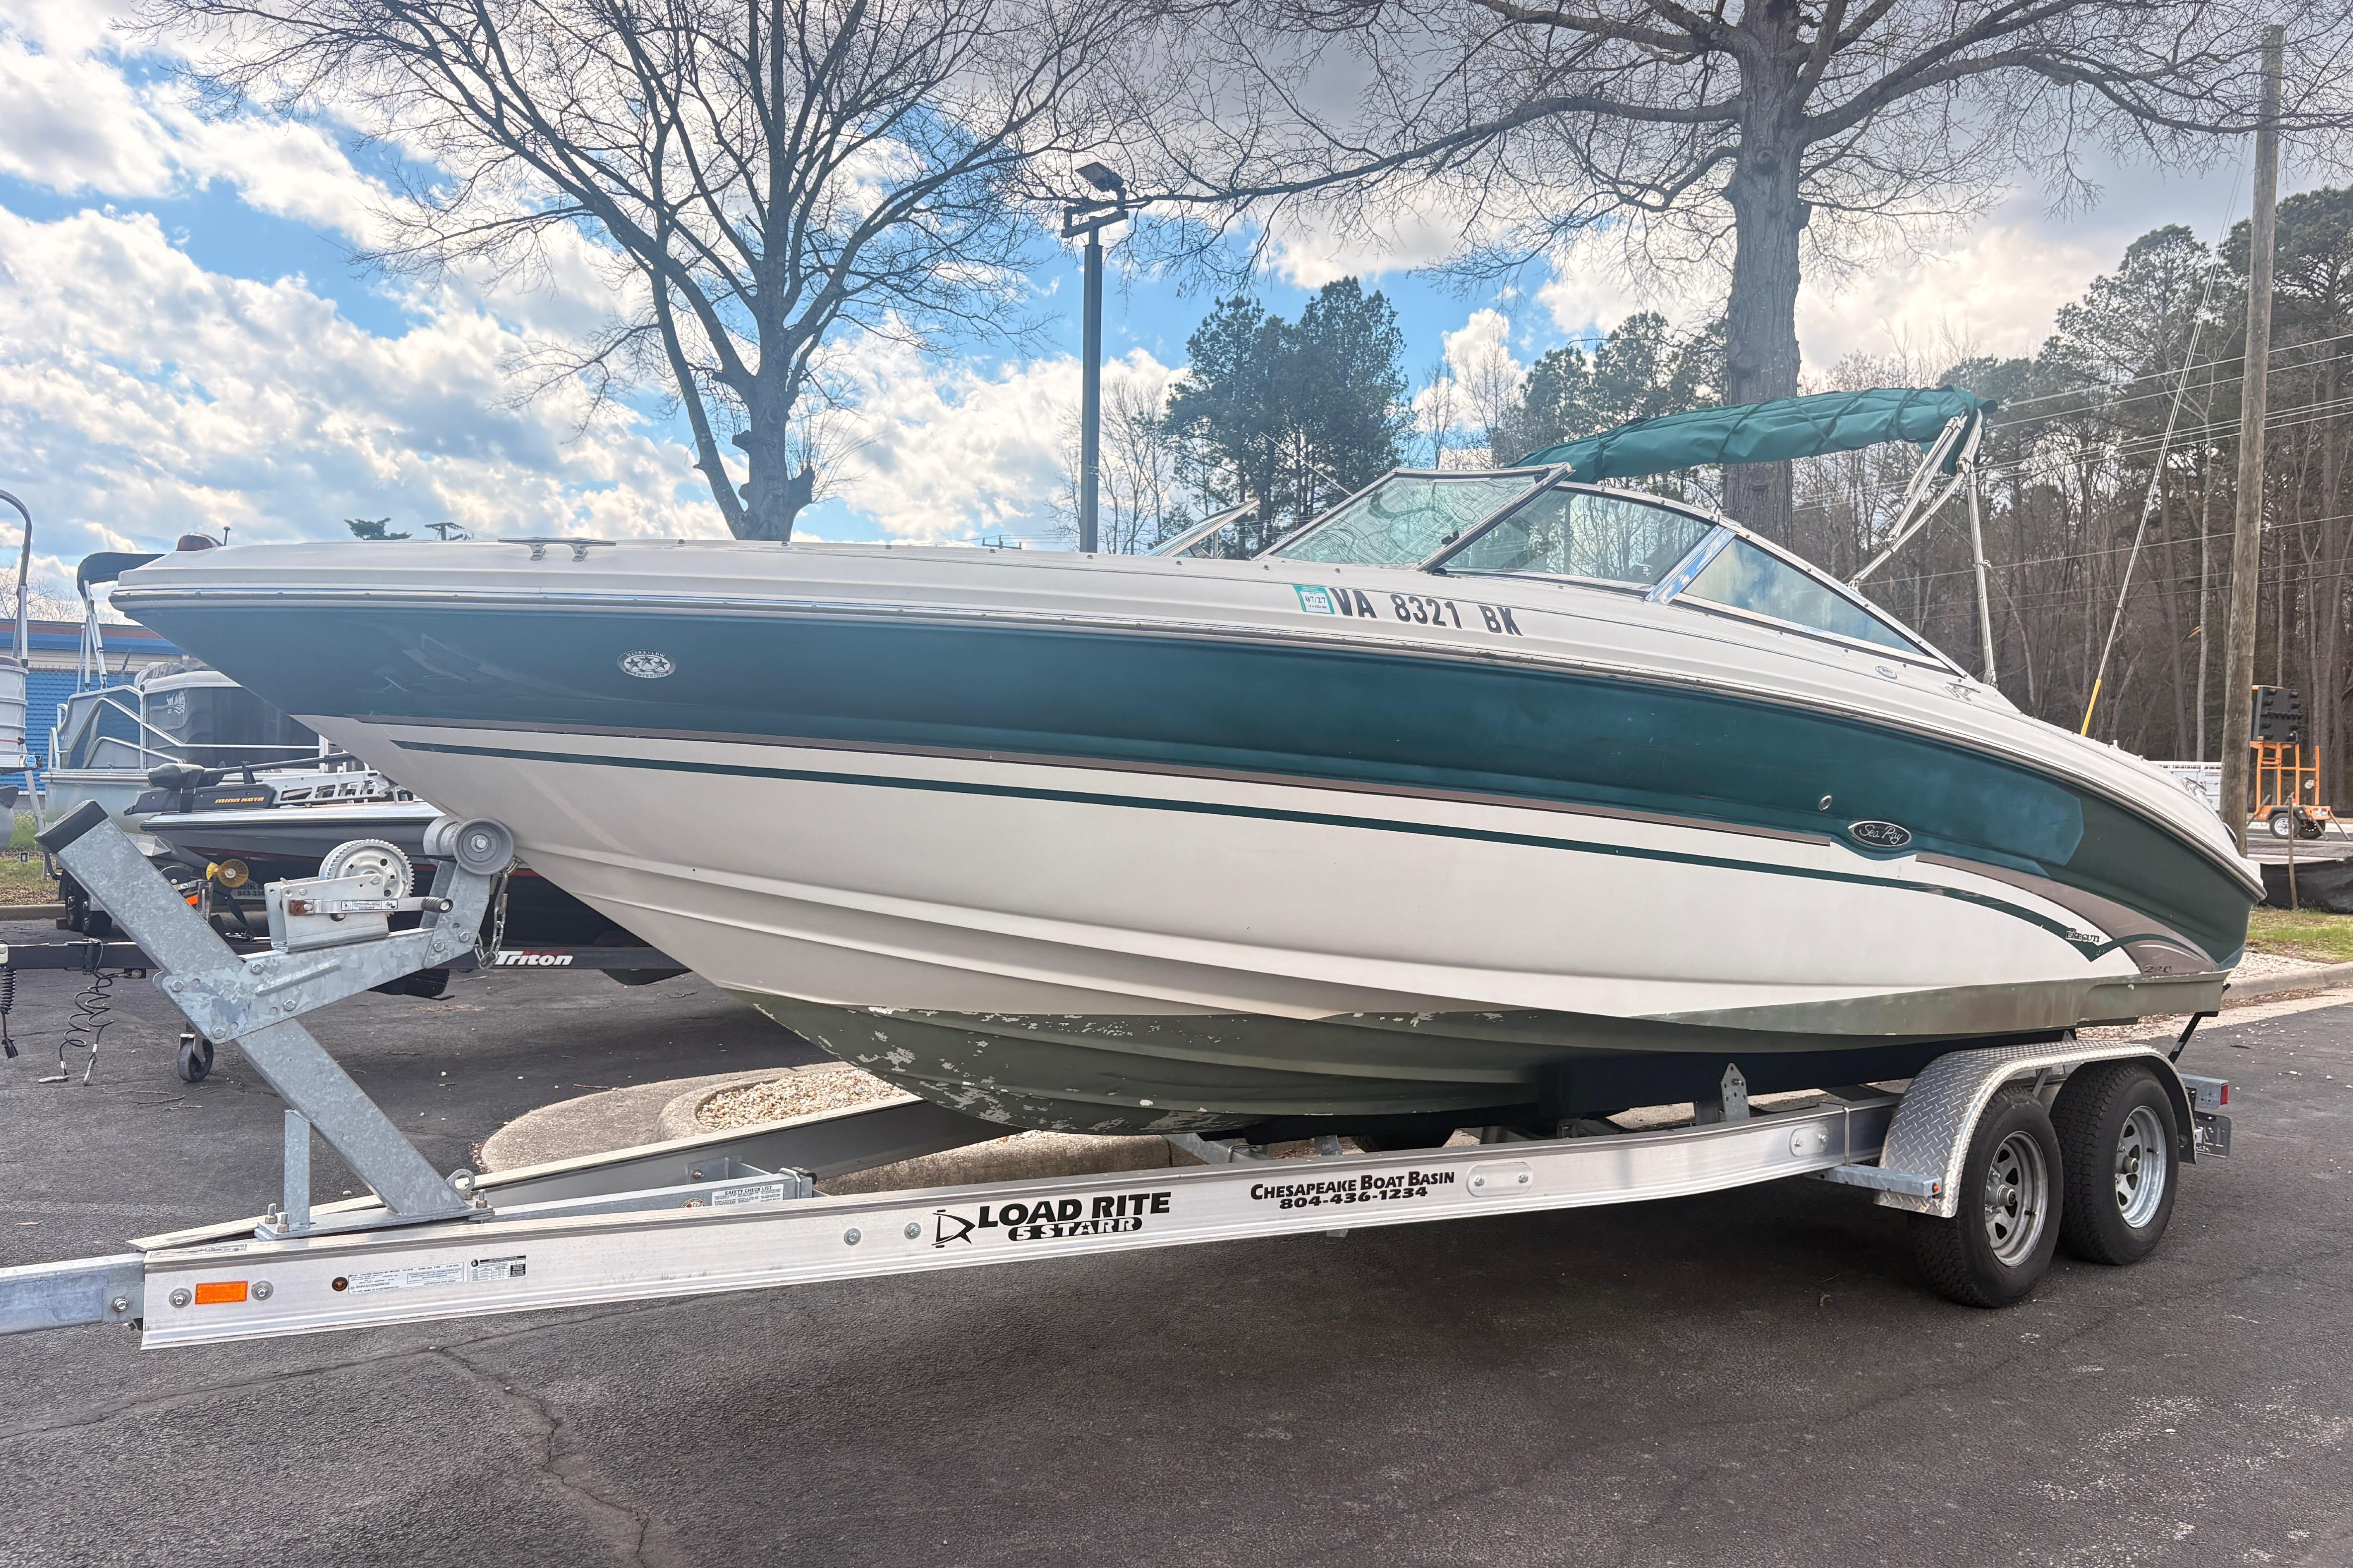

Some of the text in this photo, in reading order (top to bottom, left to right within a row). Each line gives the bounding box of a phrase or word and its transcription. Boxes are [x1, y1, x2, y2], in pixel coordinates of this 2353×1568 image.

[1329, 588, 1523, 636] VA 8321 BK
[1859, 824, 1904, 844] Sea Ray
[495, 951, 573, 966] Triton
[1250, 1171, 1454, 1200] CHESAPEAKE BOAT BASIN
[1279, 1186, 1428, 1209] 804-436-1234
[978, 1192, 1171, 1228] LOAD RITE
[1016, 1218, 1135, 1240] 5 STARR
